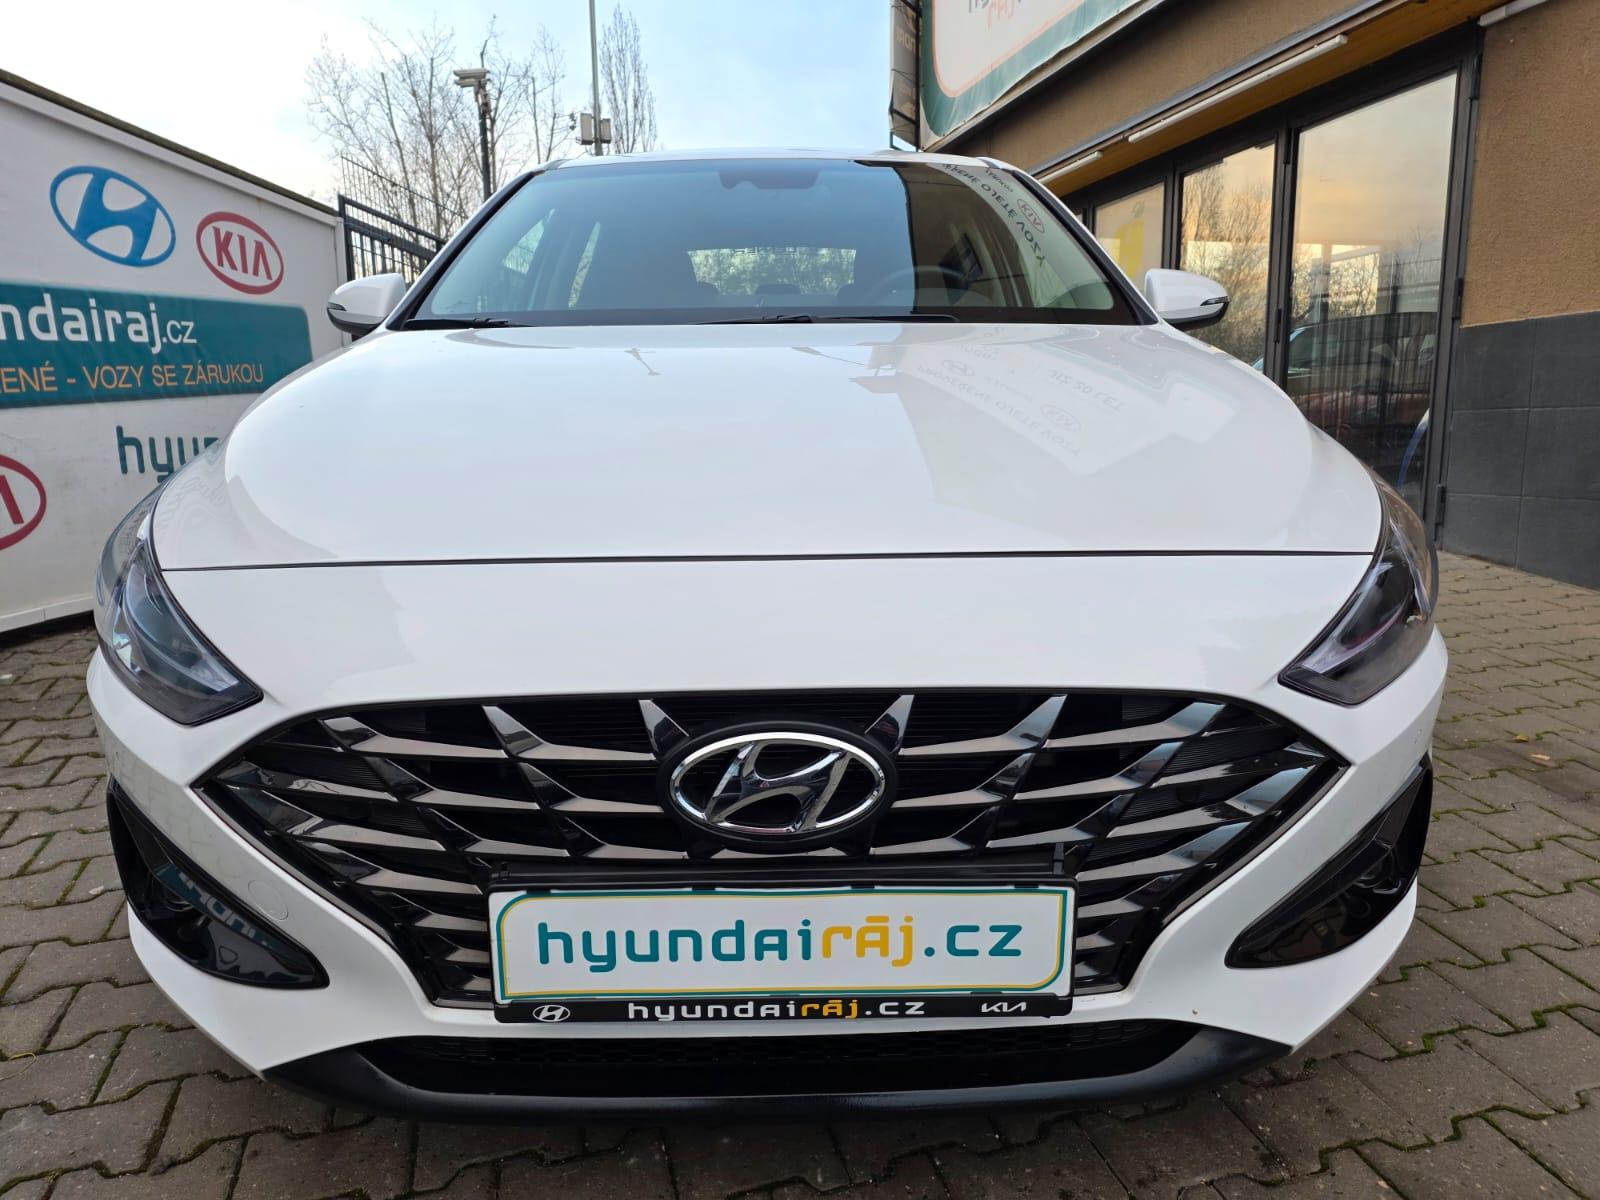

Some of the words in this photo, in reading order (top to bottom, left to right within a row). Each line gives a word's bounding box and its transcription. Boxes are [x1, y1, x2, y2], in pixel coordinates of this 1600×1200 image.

[212, 225, 273, 281] KIA
[0, 361, 59, 393] ENÉ
[82, 365, 145, 390] VOZY
[151, 364, 179, 388] SE
[181, 360, 264, 386] ZÁRUKOU
